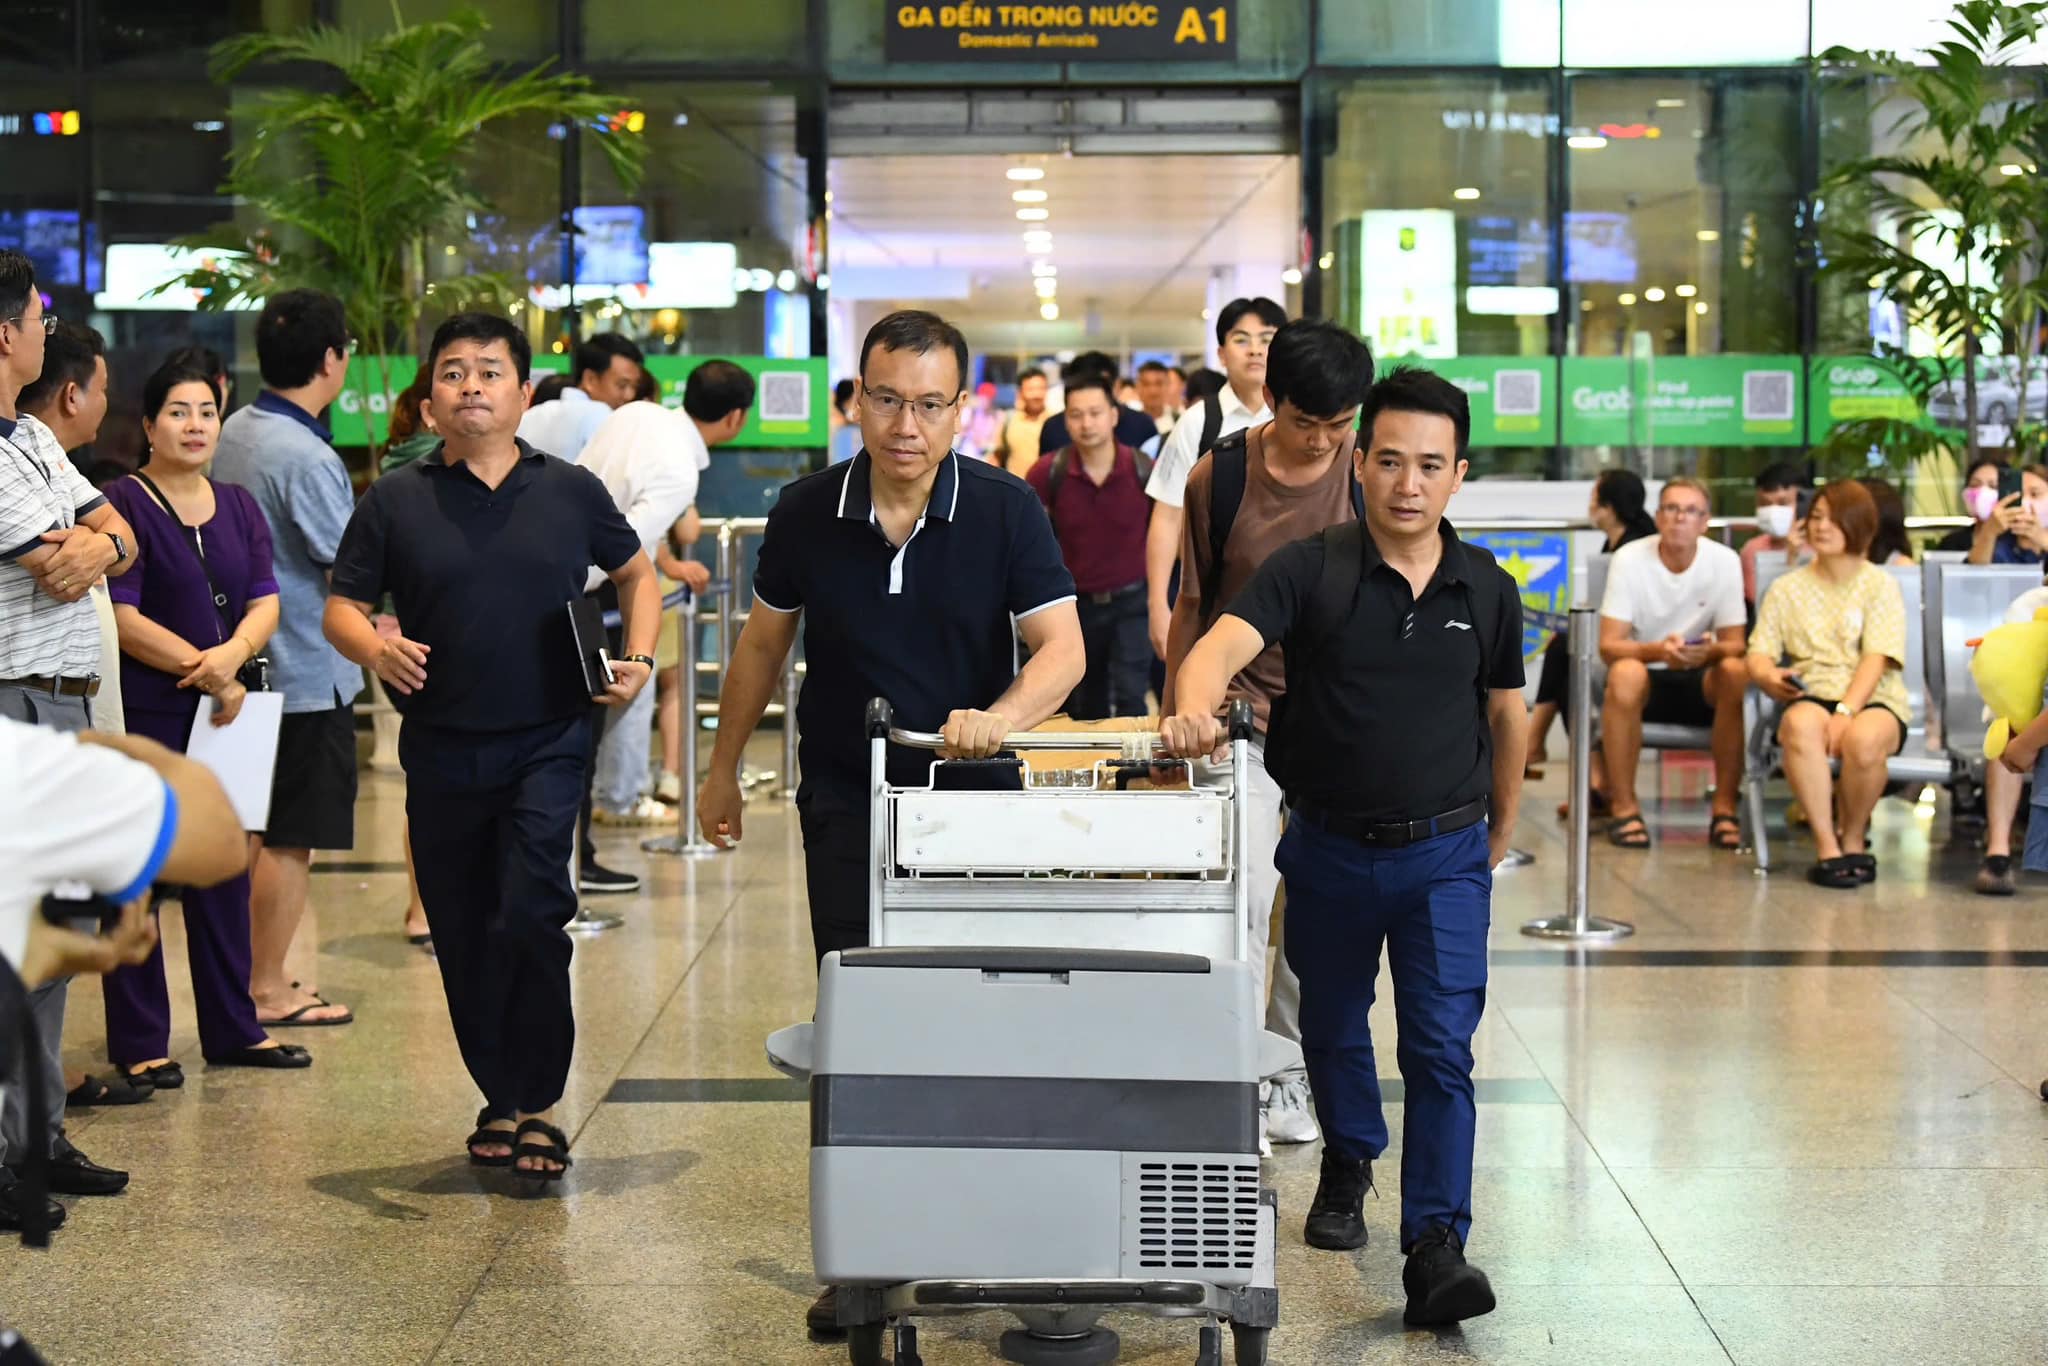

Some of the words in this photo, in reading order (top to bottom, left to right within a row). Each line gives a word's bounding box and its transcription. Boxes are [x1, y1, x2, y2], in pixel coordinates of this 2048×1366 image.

[898, 6, 934, 28] GA
[939, 0, 992, 27] ĐẾN
[997, 5, 1084, 27] TRONG
[1089, 1, 1159, 27] NƯỚC
[1174, 6, 1227, 43] A1
[958, 32, 1033, 48] Domestic
[1036, 32, 1099, 48] Arrivals
